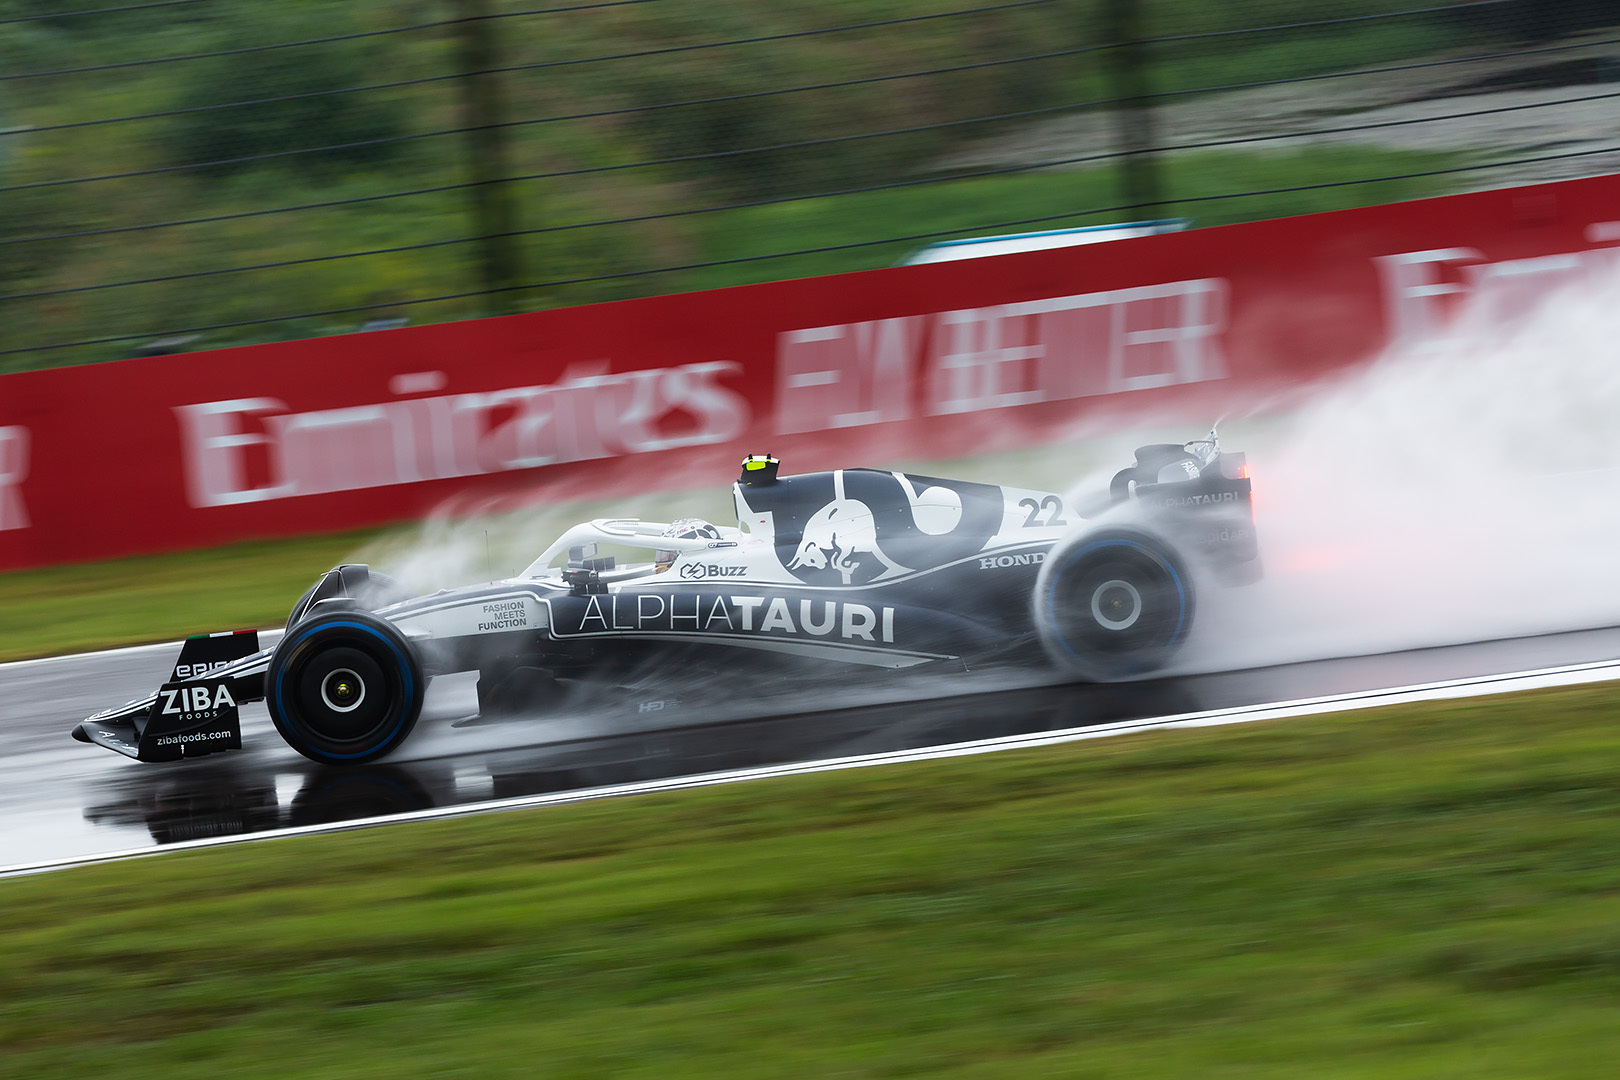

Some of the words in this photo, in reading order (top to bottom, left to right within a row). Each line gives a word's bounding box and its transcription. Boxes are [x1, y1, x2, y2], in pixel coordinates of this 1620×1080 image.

[174, 358, 746, 508] Emirates
[1018, 495, 1067, 528] 22
[979, 552, 1049, 569] HOND
[483, 601, 525, 613] FASHION
[494, 609, 526, 621] MEETS
[478, 618, 527, 631] FUNCTION
[579, 594, 895, 643] ALPHATAURI
[160, 684, 236, 715] ZIBA
[179, 711, 217, 720] FOODS
[157, 730, 231, 746] zibafoods.com
